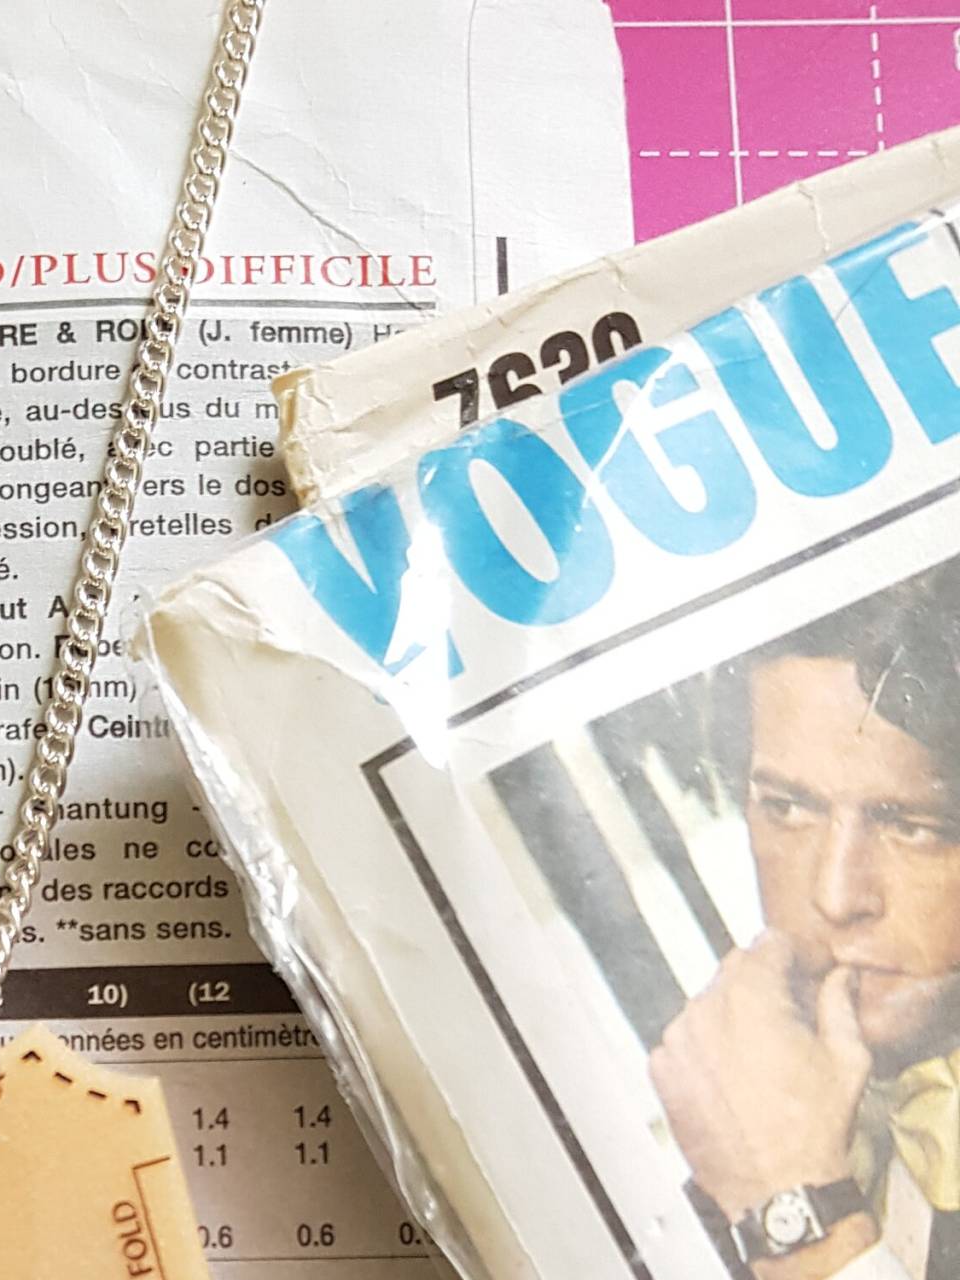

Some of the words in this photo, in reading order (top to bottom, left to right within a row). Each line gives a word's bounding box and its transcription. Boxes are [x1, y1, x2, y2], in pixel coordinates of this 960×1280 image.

[56, 321, 77, 344] &
[198, 318, 231, 347] (J.
[249, 320, 353, 349] femme)
[11, 359, 121, 384] bordure
[205, 397, 240, 418] du
[195, 435, 277, 465] partie
[198, 473, 222, 496] le
[235, 472, 288, 500] dos
[124, 841, 159, 860] ne
[41, 878, 93, 902] des
[103, 874, 230, 900] raccords
[156, 920, 232, 940] sens.
[87, 984, 128, 1008] 10)
[188, 981, 230, 1007] (12
